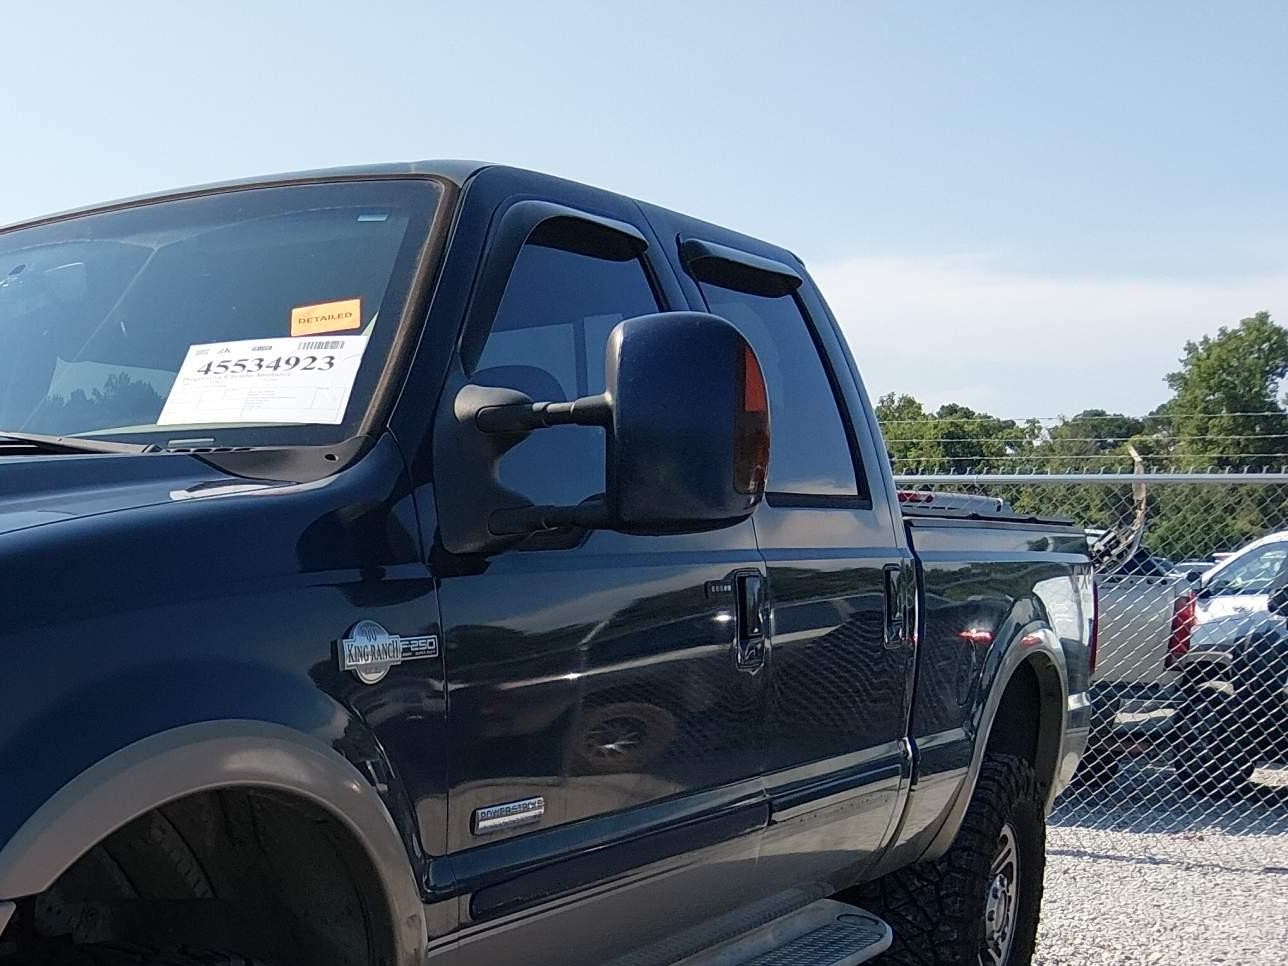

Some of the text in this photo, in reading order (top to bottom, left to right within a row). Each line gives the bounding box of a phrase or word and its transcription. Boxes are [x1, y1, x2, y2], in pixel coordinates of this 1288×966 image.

[298, 312, 353, 325] DETAILED
[196, 355, 336, 375] 45534923
[347, 639, 399, 663] KING RANCH
[400, 638, 435, 653] F-250
